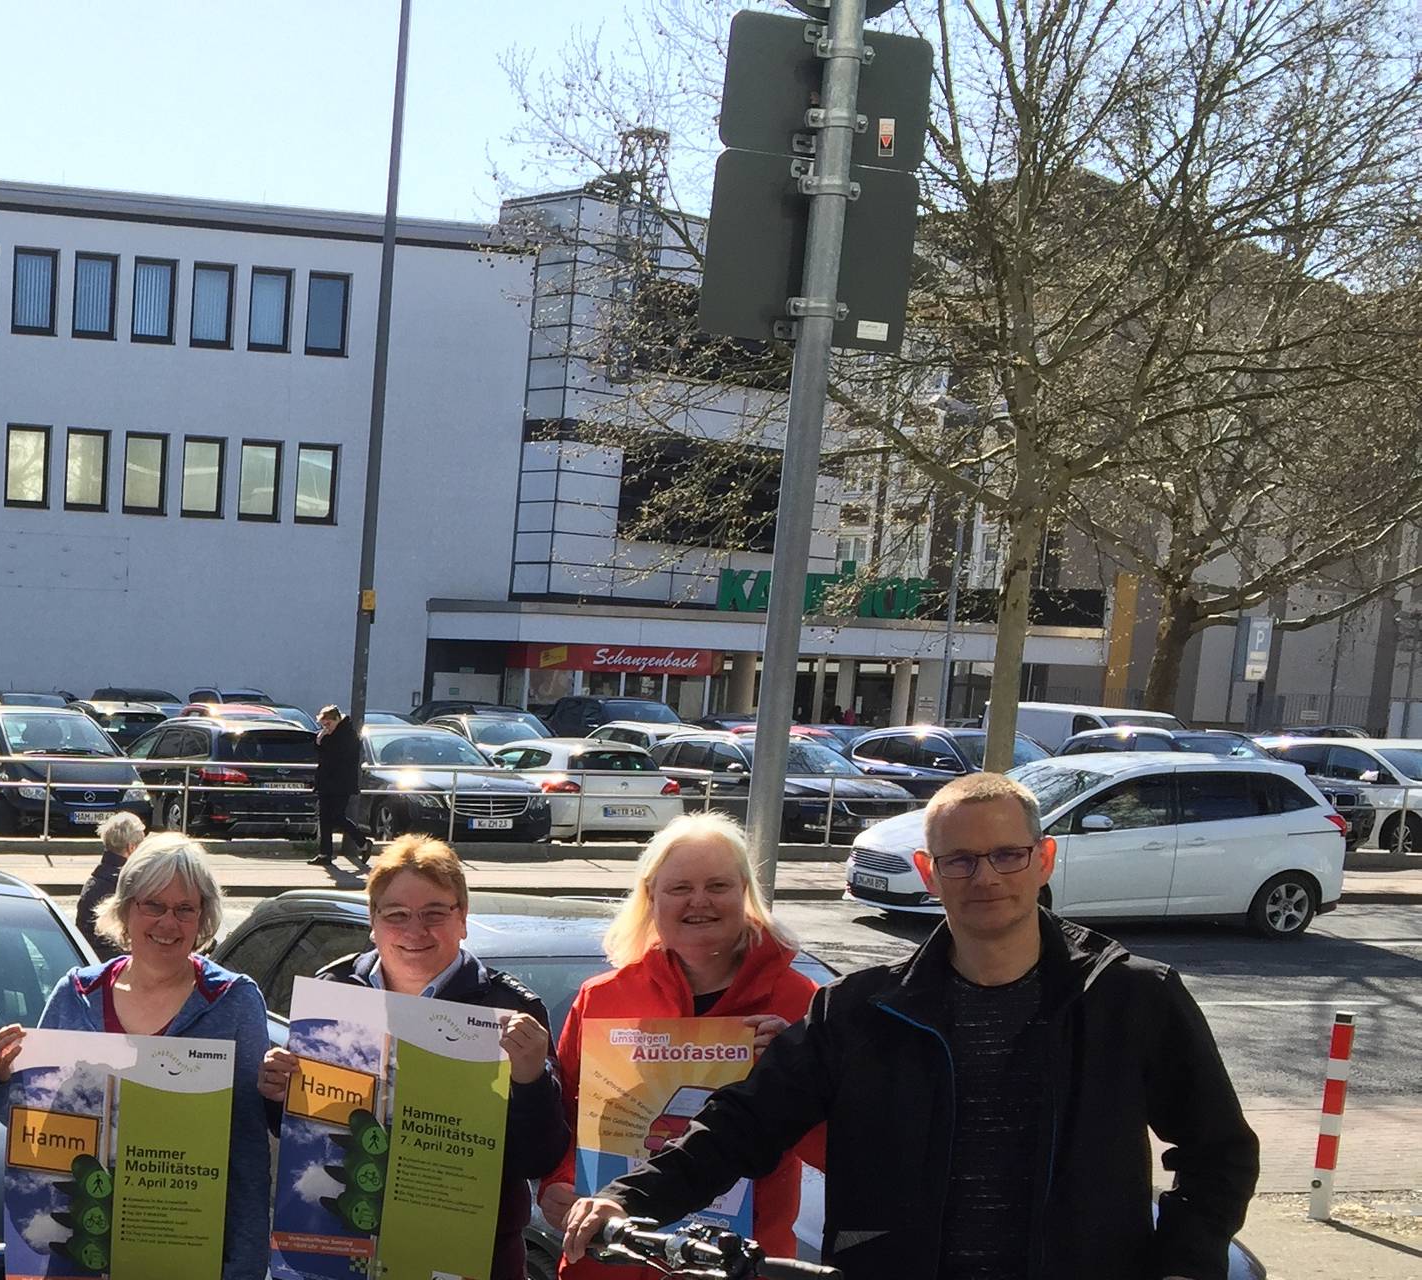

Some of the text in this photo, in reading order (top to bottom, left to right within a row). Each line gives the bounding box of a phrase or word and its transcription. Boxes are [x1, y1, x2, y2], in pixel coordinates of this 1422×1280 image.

[592, 647, 698, 672] Schanzenbach
[611, 1032, 669, 1046] umsteigen!
[188, 1049, 227, 1060] Hamm:
[632, 1044, 748, 1061] Autofasten
[301, 1074, 364, 1106] Hamm
[402, 1105, 463, 1127] Hammer
[21, 1126, 86, 1151] Hamm
[401, 1120, 496, 1150] Mobilitätstag
[125, 1145, 187, 1161] Hammer
[400, 1135, 475, 1158] 7. April 2019
[125, 1159, 220, 1180] Mobilitätstag
[124, 1175, 199, 1191] 7. April 2019
